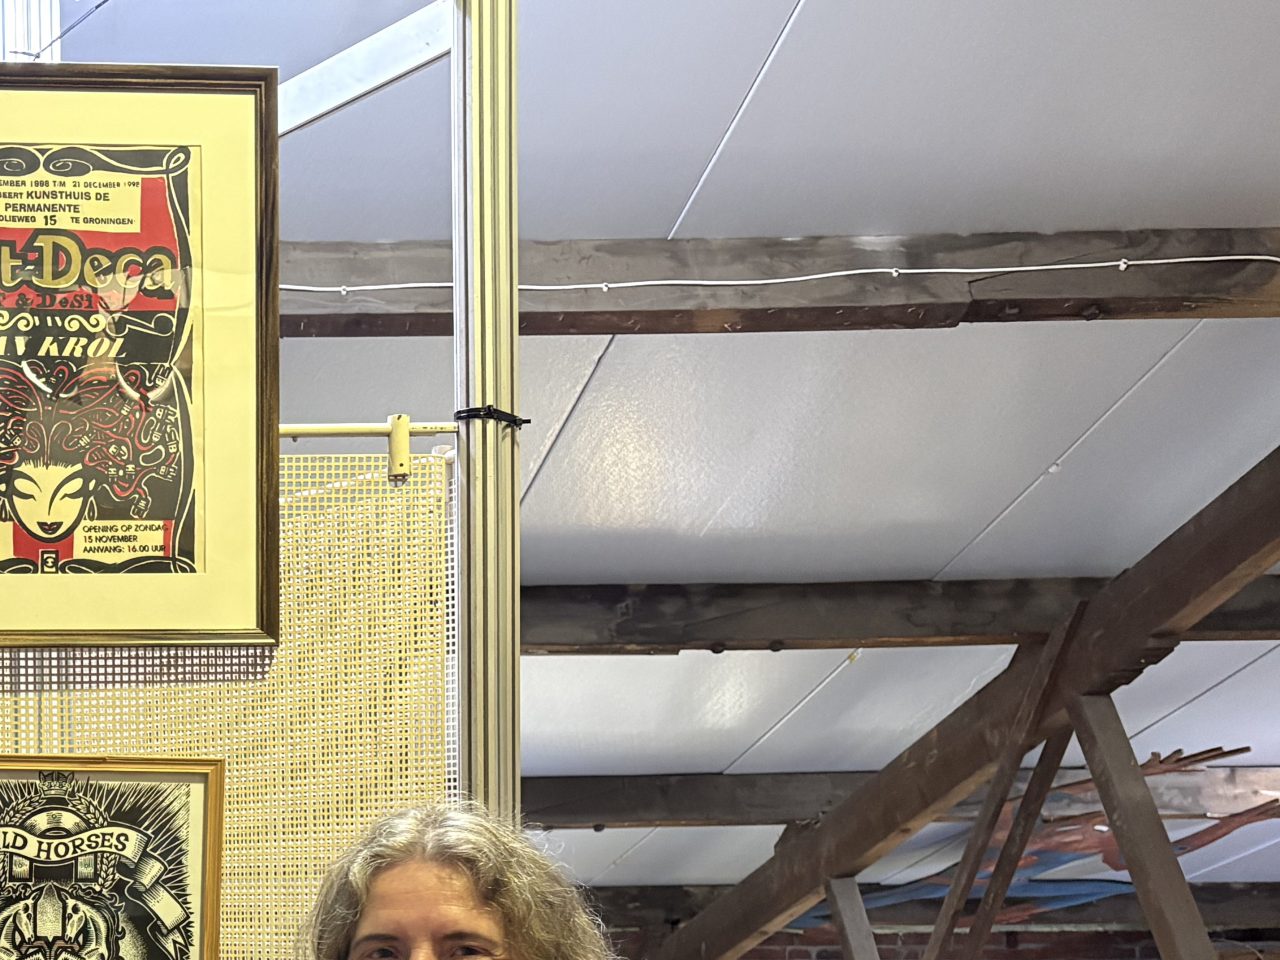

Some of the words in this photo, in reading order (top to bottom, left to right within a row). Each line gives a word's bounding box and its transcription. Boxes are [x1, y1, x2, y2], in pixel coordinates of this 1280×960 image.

[72, 180, 80, 188] 21
[83, 181, 121, 189] DECEMBER
[26, 190, 92, 201] KUNSTHUIS
[95, 192, 110, 201] DE
[4, 202, 80, 213] PERMANENTE
[43, 215, 57, 226] 15
[70, 216, 80, 224] TE
[83, 217, 134, 225] GRONINGEN
[37, 336, 127, 358] KROL
[83, 525, 119, 533] OPENING
[120, 524, 133, 532] OP
[134, 524, 169, 532] ZONDAG
[84, 535, 93, 543] 15
[95, 535, 138, 543] NOVEMBER
[83, 545, 124, 553] AANVANG:
[127, 545, 149, 553] 16.00
[34, 832, 129, 860] HORSES
